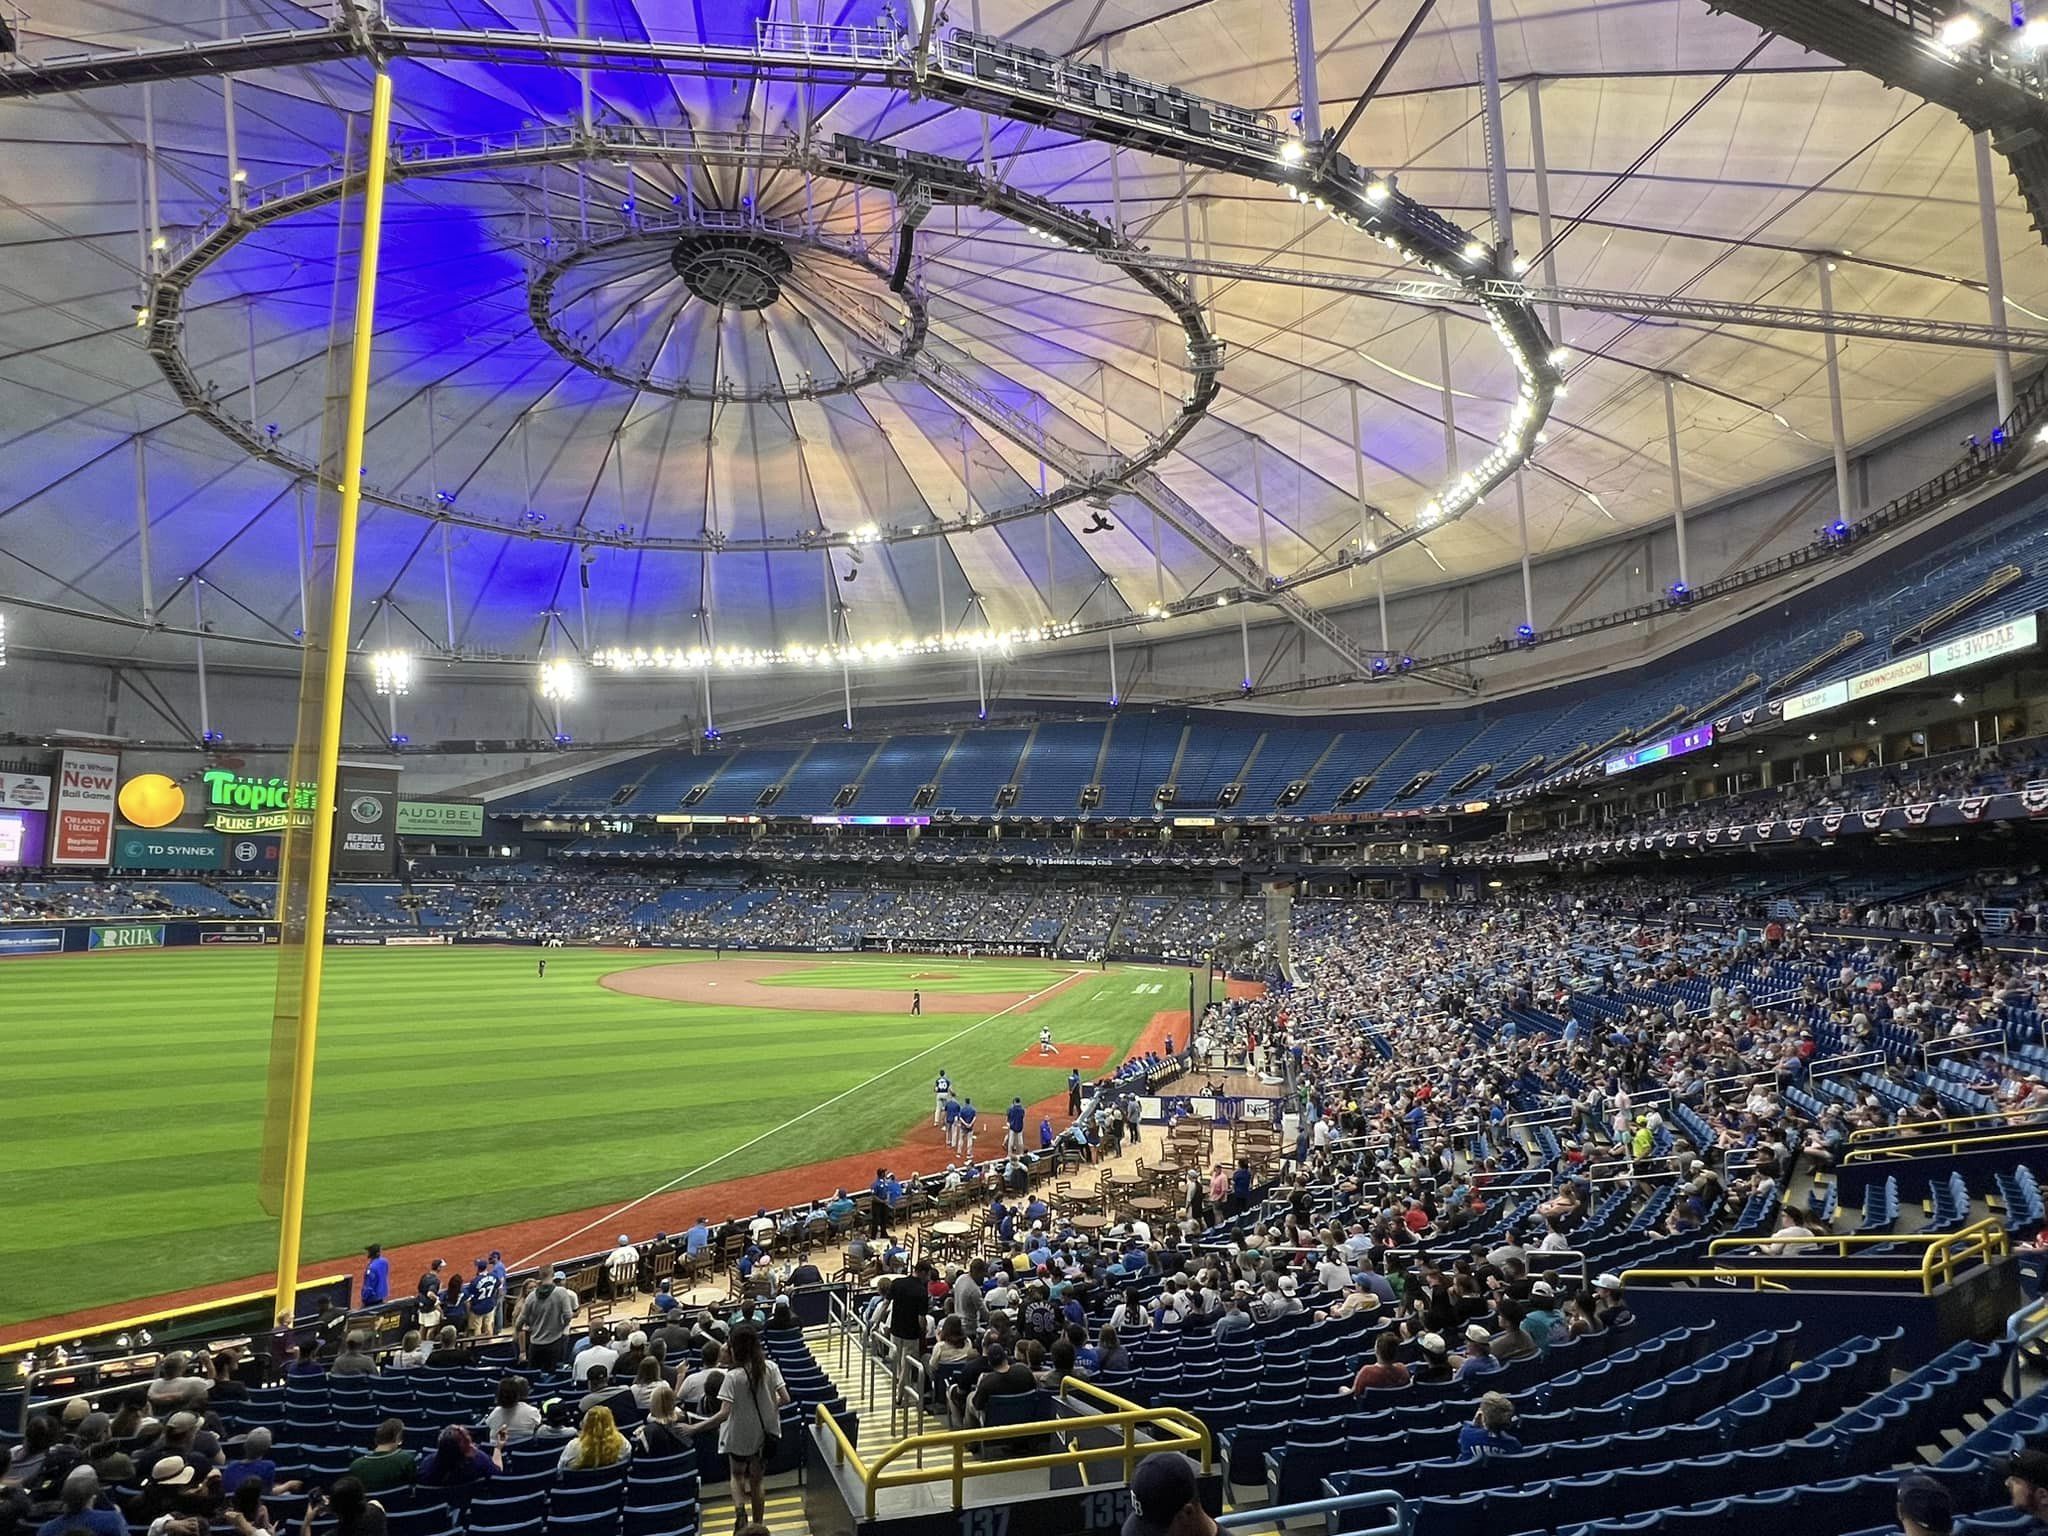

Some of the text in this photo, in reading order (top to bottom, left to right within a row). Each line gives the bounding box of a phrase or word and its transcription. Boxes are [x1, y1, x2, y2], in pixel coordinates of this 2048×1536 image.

[64, 771, 113, 790] New
[63, 790, 81, 798] Ball
[399, 807, 481, 820] AUDIBEL
[65, 816, 105, 825] ORLANDO
[216, 815, 253, 829] PURE
[68, 824, 101, 832] HEALTH
[147, 845, 215, 855] TD SYNNEX
[343, 842, 385, 851] AMERICAS
[478, 1285, 494, 1300] 27
[1130, 1489, 1144, 1517] TB
[1081, 1492, 1130, 1529] 135
[958, 1506, 1010, 1536] 137
